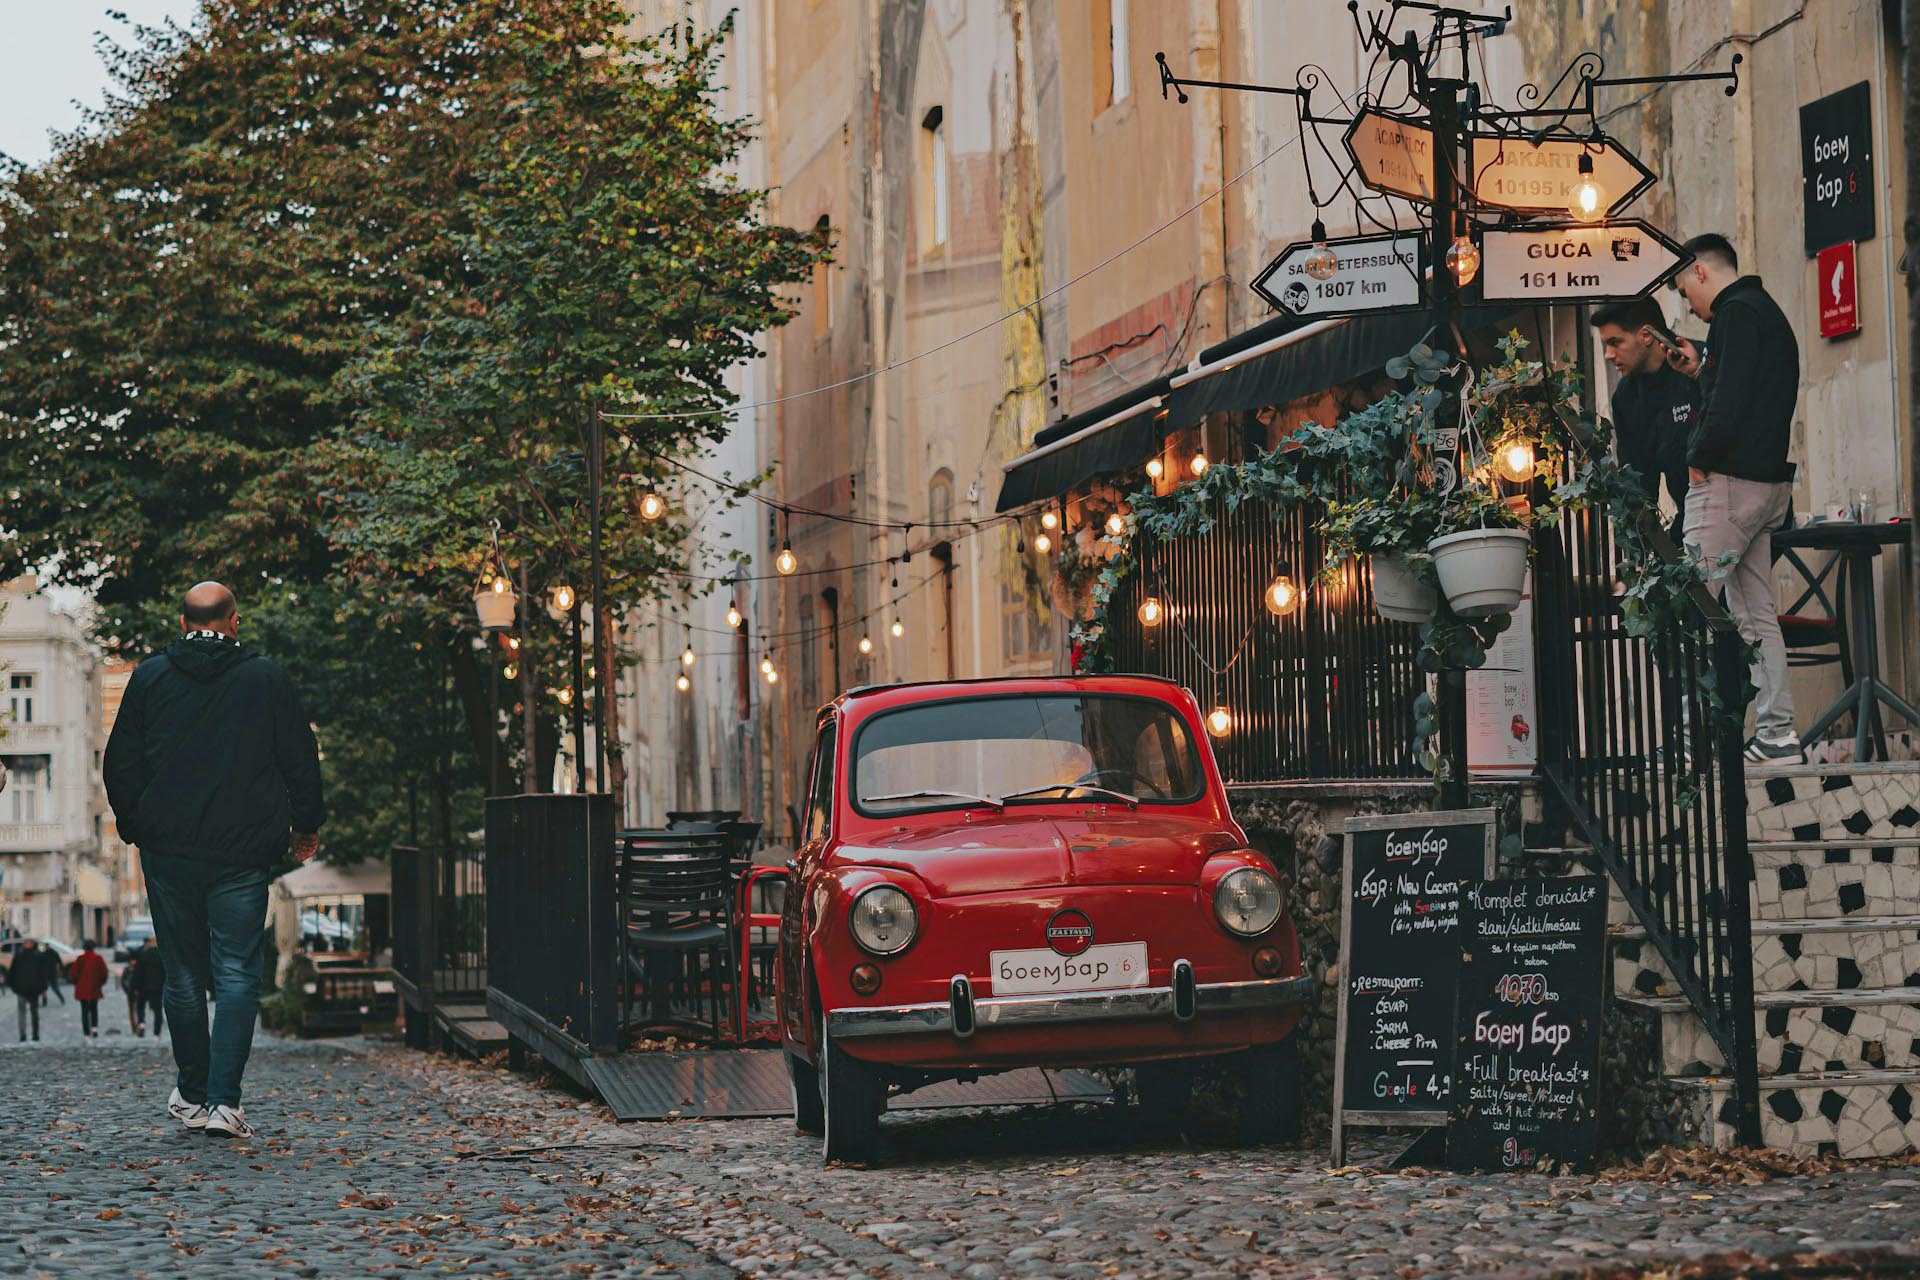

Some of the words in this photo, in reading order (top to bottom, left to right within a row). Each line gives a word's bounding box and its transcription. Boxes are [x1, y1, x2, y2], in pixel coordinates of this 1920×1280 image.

[1497, 151, 1582, 169] JAKART
[1495, 179, 1553, 196] 10195
[1527, 239, 1593, 259] GUČA
[1328, 252, 1414, 271] PETERSBURG
[1520, 272, 1557, 288] 161
[1567, 271, 1600, 287] km
[1315, 281, 1355, 299] 1807
[1361, 280, 1387, 295] km
[1424, 871, 1459, 895] COCKTA
[1394, 899, 1412, 915] with
[1051, 928, 1089, 936] ZASTAVA
[1513, 942, 1539, 955] toplim
[1524, 956, 1549, 966] sokom
[1472, 1054, 1499, 1081] Full
[1508, 1055, 1580, 1095] breakfast
[1373, 1071, 1417, 1103] Google
[1481, 1102, 1503, 1116] with
[1515, 1105, 1533, 1118] hot
[1492, 1118, 1511, 1131] and
